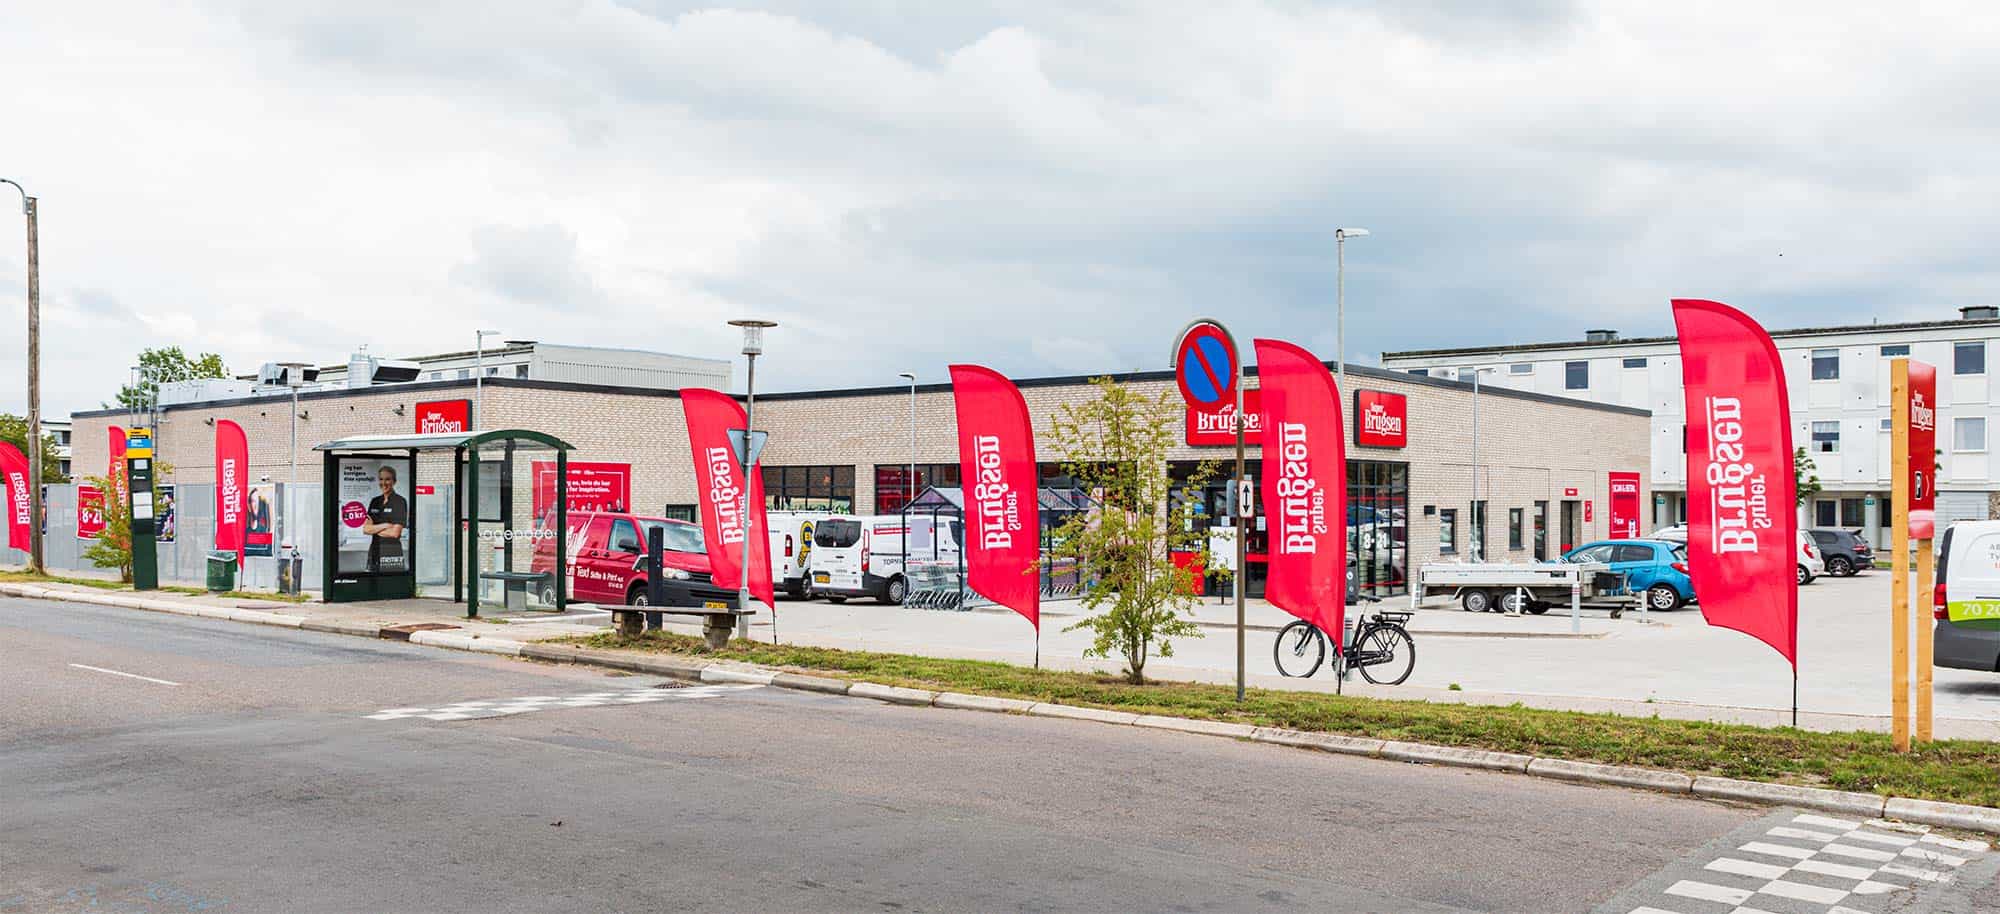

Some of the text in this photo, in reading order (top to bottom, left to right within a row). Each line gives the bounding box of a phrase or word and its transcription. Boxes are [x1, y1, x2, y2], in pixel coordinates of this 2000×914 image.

[422, 418, 461, 434] Brugsen
[1364, 409, 1401, 436] Brugsen
[1962, 602, 1982, 616] 70
